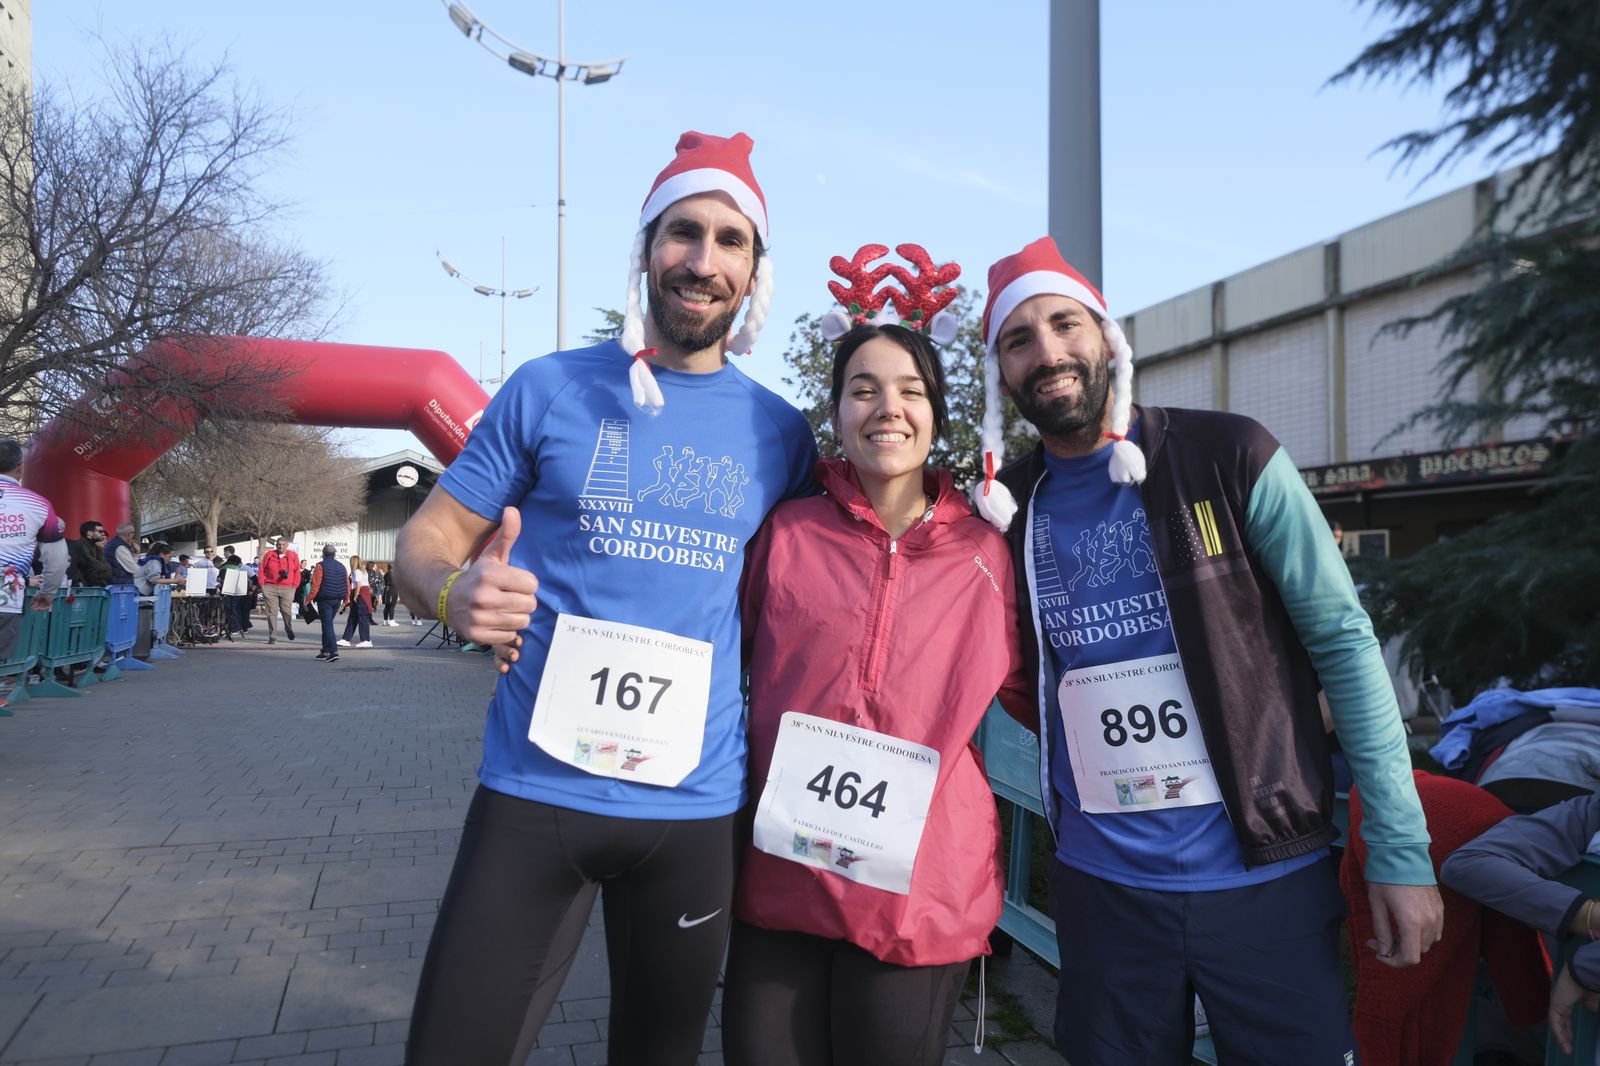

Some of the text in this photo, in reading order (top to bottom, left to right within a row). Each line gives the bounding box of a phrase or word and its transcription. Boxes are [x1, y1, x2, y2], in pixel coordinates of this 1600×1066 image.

[428, 398, 466, 439] Diputación
[578, 499, 634, 513] XXXVIII
[579, 515, 739, 554] SAN SILVESTRE
[589, 536, 725, 572] CORDOBESA
[1039, 595, 1070, 609] XXVIII
[1045, 589, 1166, 629] AN SILVESTR
[581, 626, 599, 637] SAN
[601, 630, 654, 646] SILVESTRE
[654, 639, 705, 658] CORDOBESA
[589, 667, 673, 715] 167
[1076, 676, 1093, 686] SAN
[1094, 667, 1146, 683] SILVESTRE
[1148, 661, 1182, 674] CORDO
[1100, 699, 1188, 748] 896
[805, 723, 823, 734] SAN
[825, 728, 875, 747] SILVESTRE
[876, 742, 932, 764] CORDOBESA
[1100, 758, 1210, 777] FRANCISCO VELASCO SANTAMARI
[806, 764, 889, 819] 464
[793, 818, 821, 831] PATRICIA
[822, 827, 843, 838] LUQUE
[844, 834, 884, 851] CASTILLEJO
